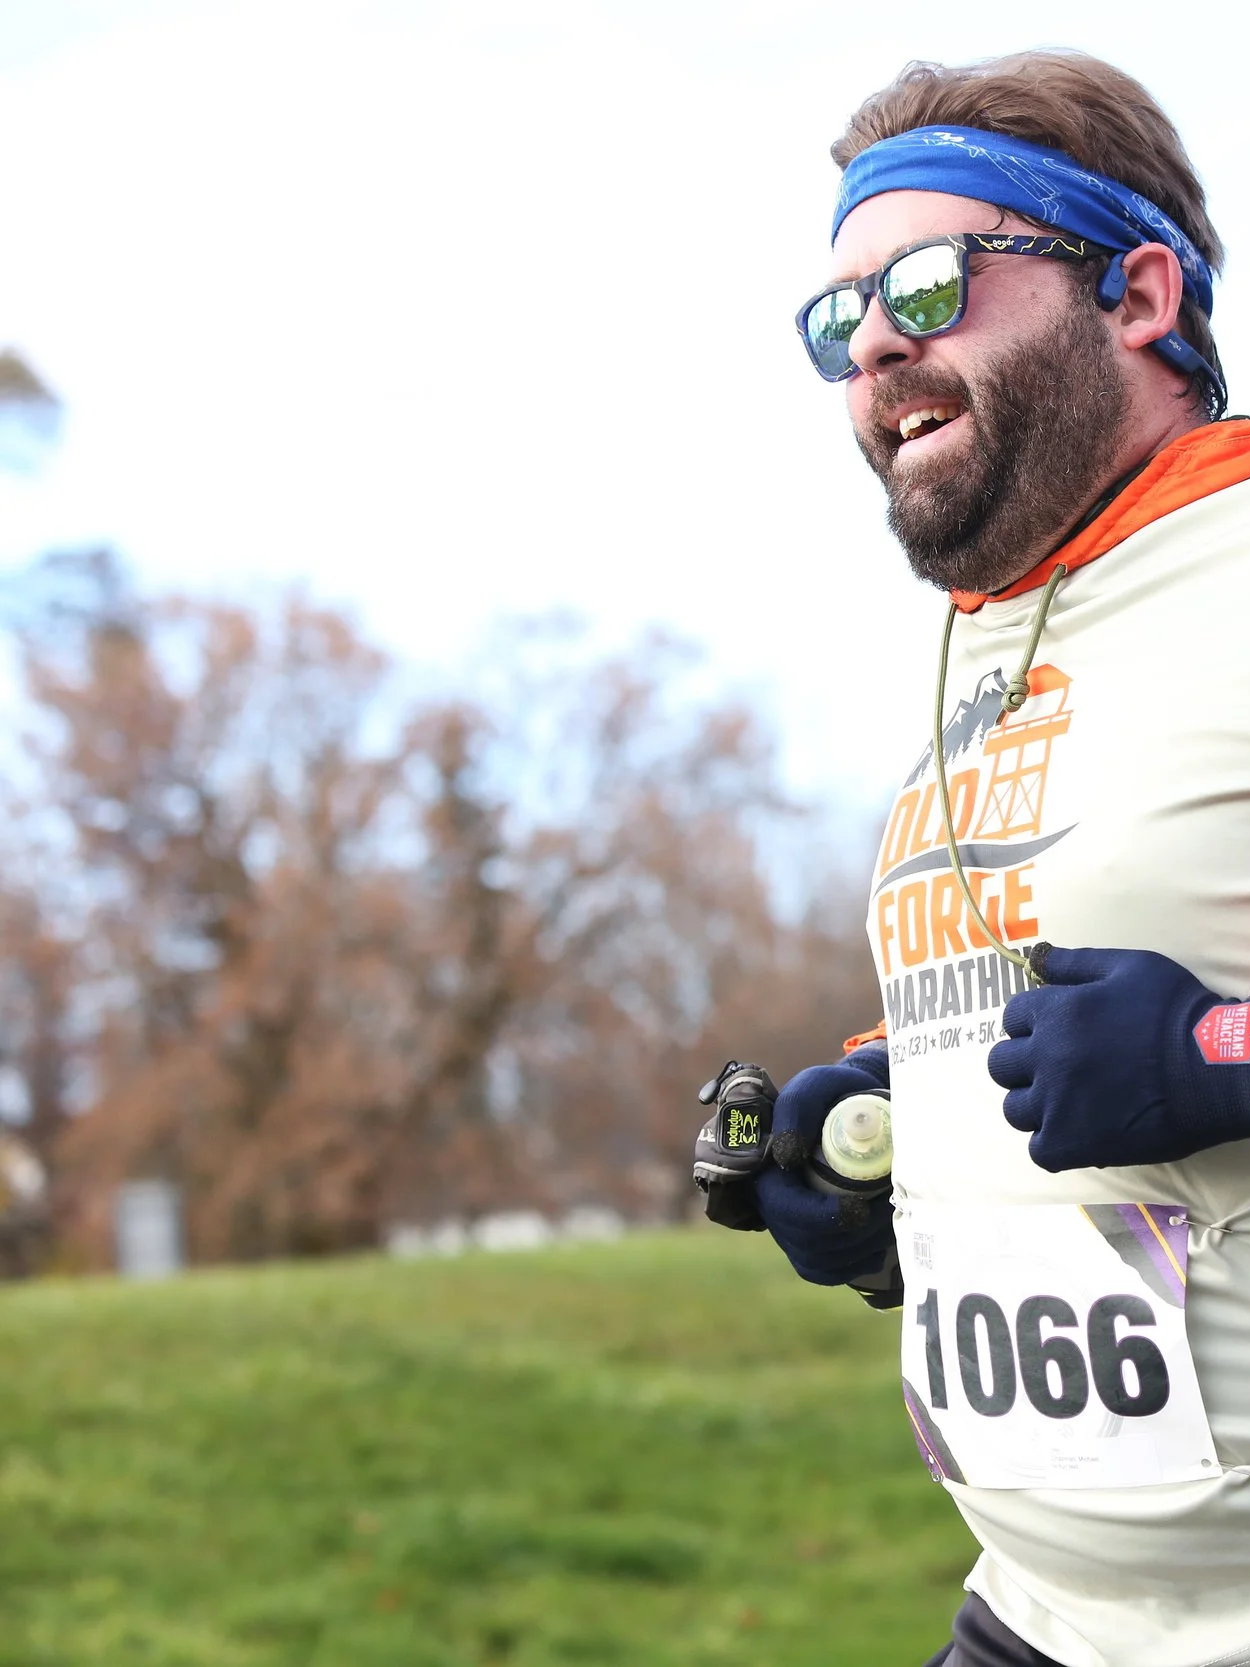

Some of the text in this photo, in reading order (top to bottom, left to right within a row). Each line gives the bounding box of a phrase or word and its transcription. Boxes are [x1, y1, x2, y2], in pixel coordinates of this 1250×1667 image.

[880, 768, 981, 879] OLD
[877, 862, 1039, 977] FORGE
[939, 1026, 962, 1051] 10K
[979, 1020, 997, 1045] 5K
[1219, 1017, 1234, 1044] RACE
[1232, 1005, 1249, 1058] VETERANS
[728, 1109, 740, 1148] amphipod
[916, 1288, 1170, 1419] 1066
